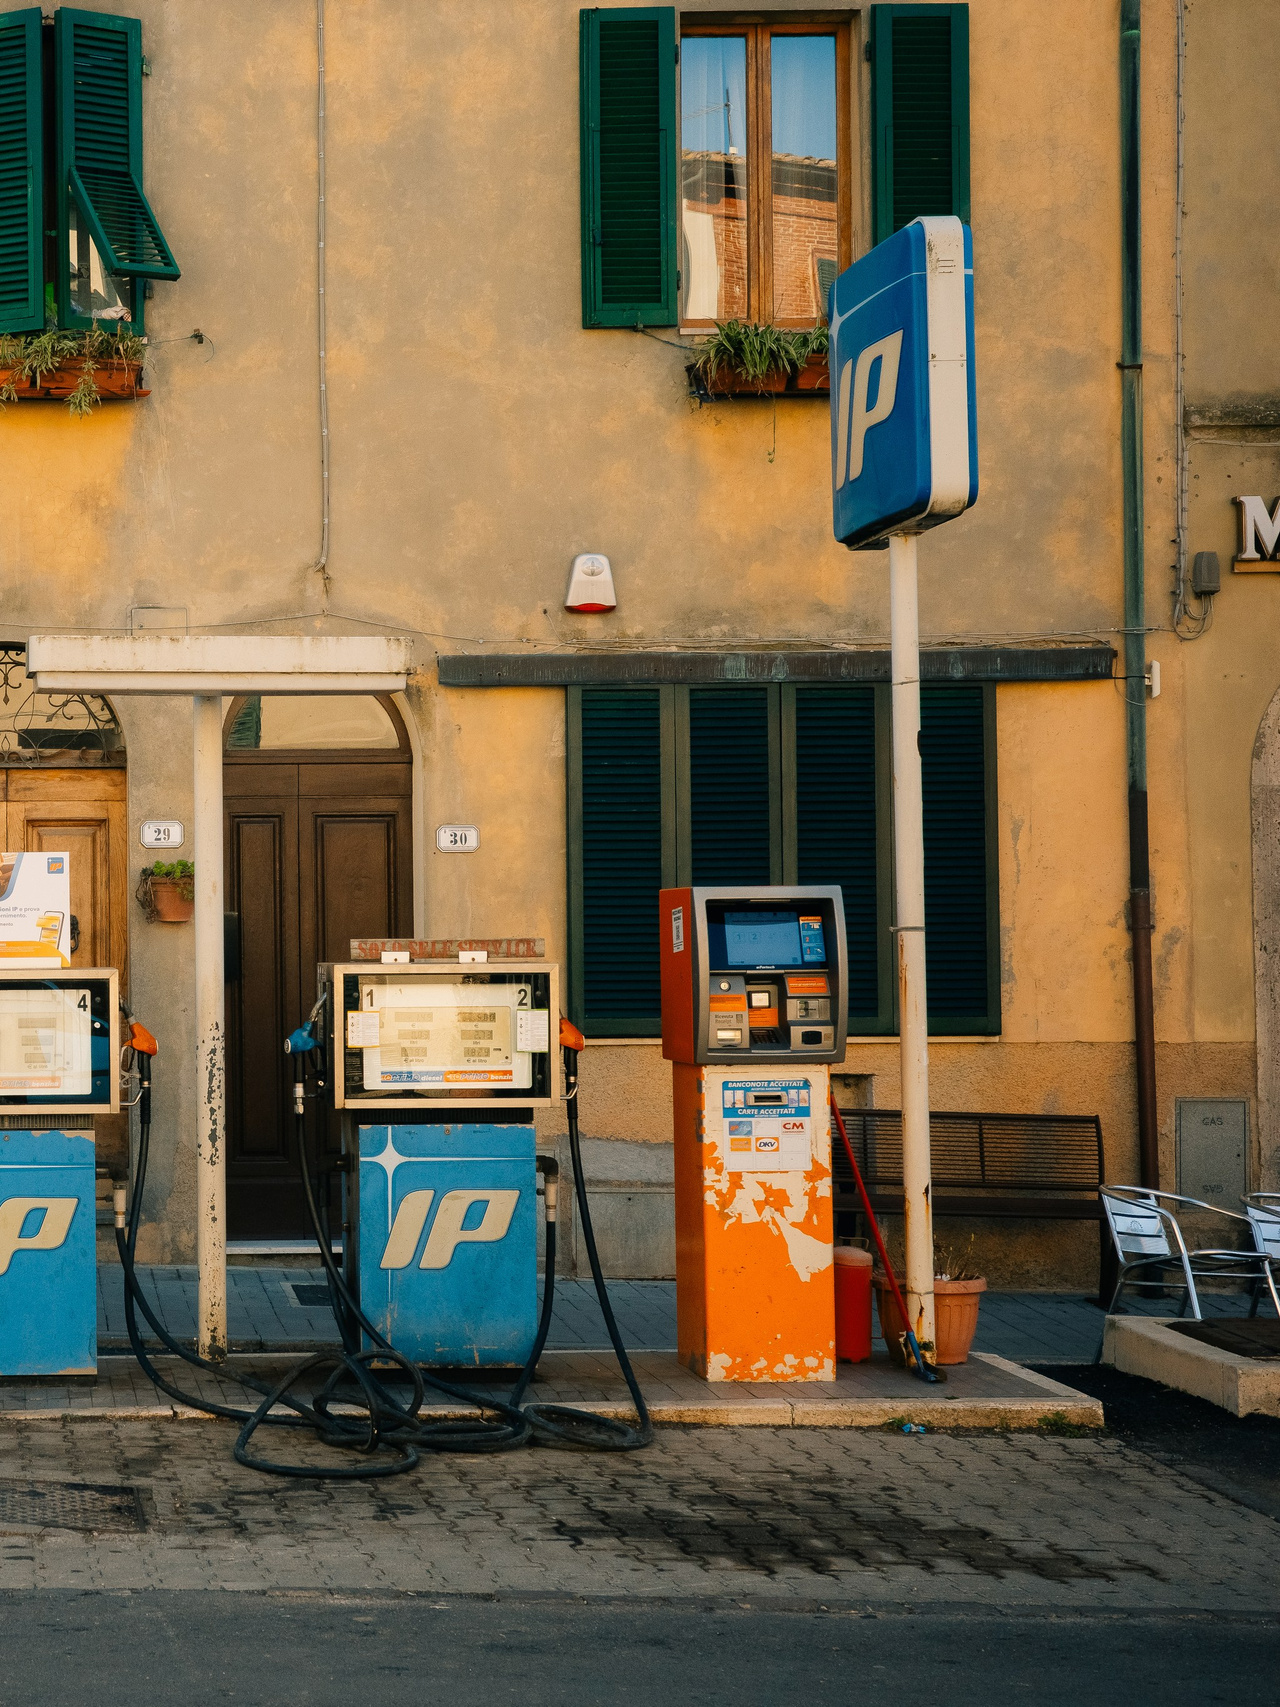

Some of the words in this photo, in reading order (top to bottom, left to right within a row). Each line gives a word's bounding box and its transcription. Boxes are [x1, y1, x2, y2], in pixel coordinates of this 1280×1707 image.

[836, 329, 904, 491] IP
[154, 828, 170, 841] 29
[450, 832, 467, 845] 30
[50, 863, 62, 871] IP
[77, 994, 88, 1011] 4
[366, 989, 374, 1007] 1
[517, 988, 528, 1006] 2
[783, 1122, 804, 1130] CM
[1203, 1117, 1223, 1126] GAS
[379, 1189, 521, 1270] IP
